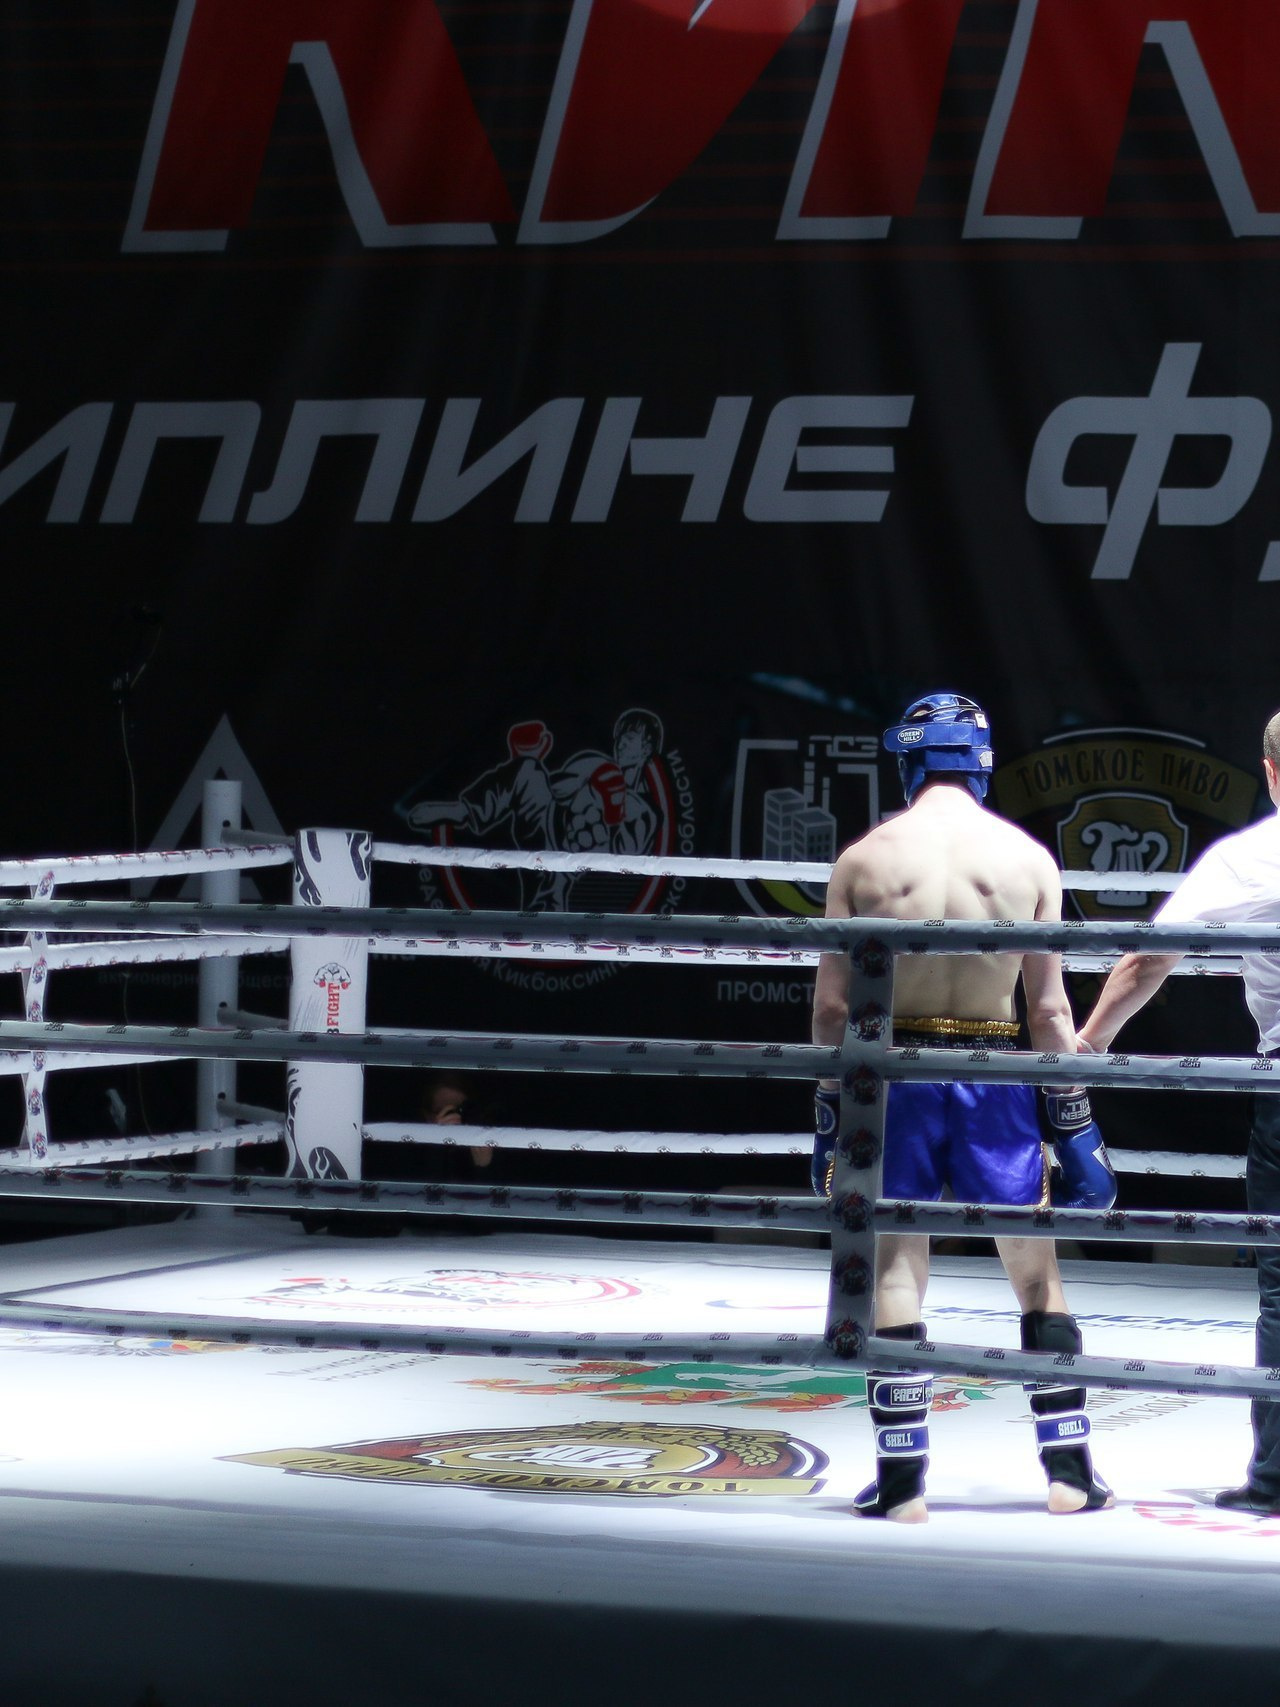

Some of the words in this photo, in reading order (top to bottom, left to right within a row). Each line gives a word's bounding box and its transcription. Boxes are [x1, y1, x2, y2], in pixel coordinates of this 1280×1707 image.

[1016, 748, 1145, 799] ТОМСКОЕ
[1160, 754, 1230, 803] ПИВО
[717, 980, 815, 1004] ПРОМСТ
[326, 982, 341, 1027] FIGHT
[894, 1394, 919, 1402] HILL
[1057, 1420, 1085, 1437] SHELL
[885, 1433, 914, 1448] SHELL
[441, 1471, 749, 1494] ТОМСКОЕ
